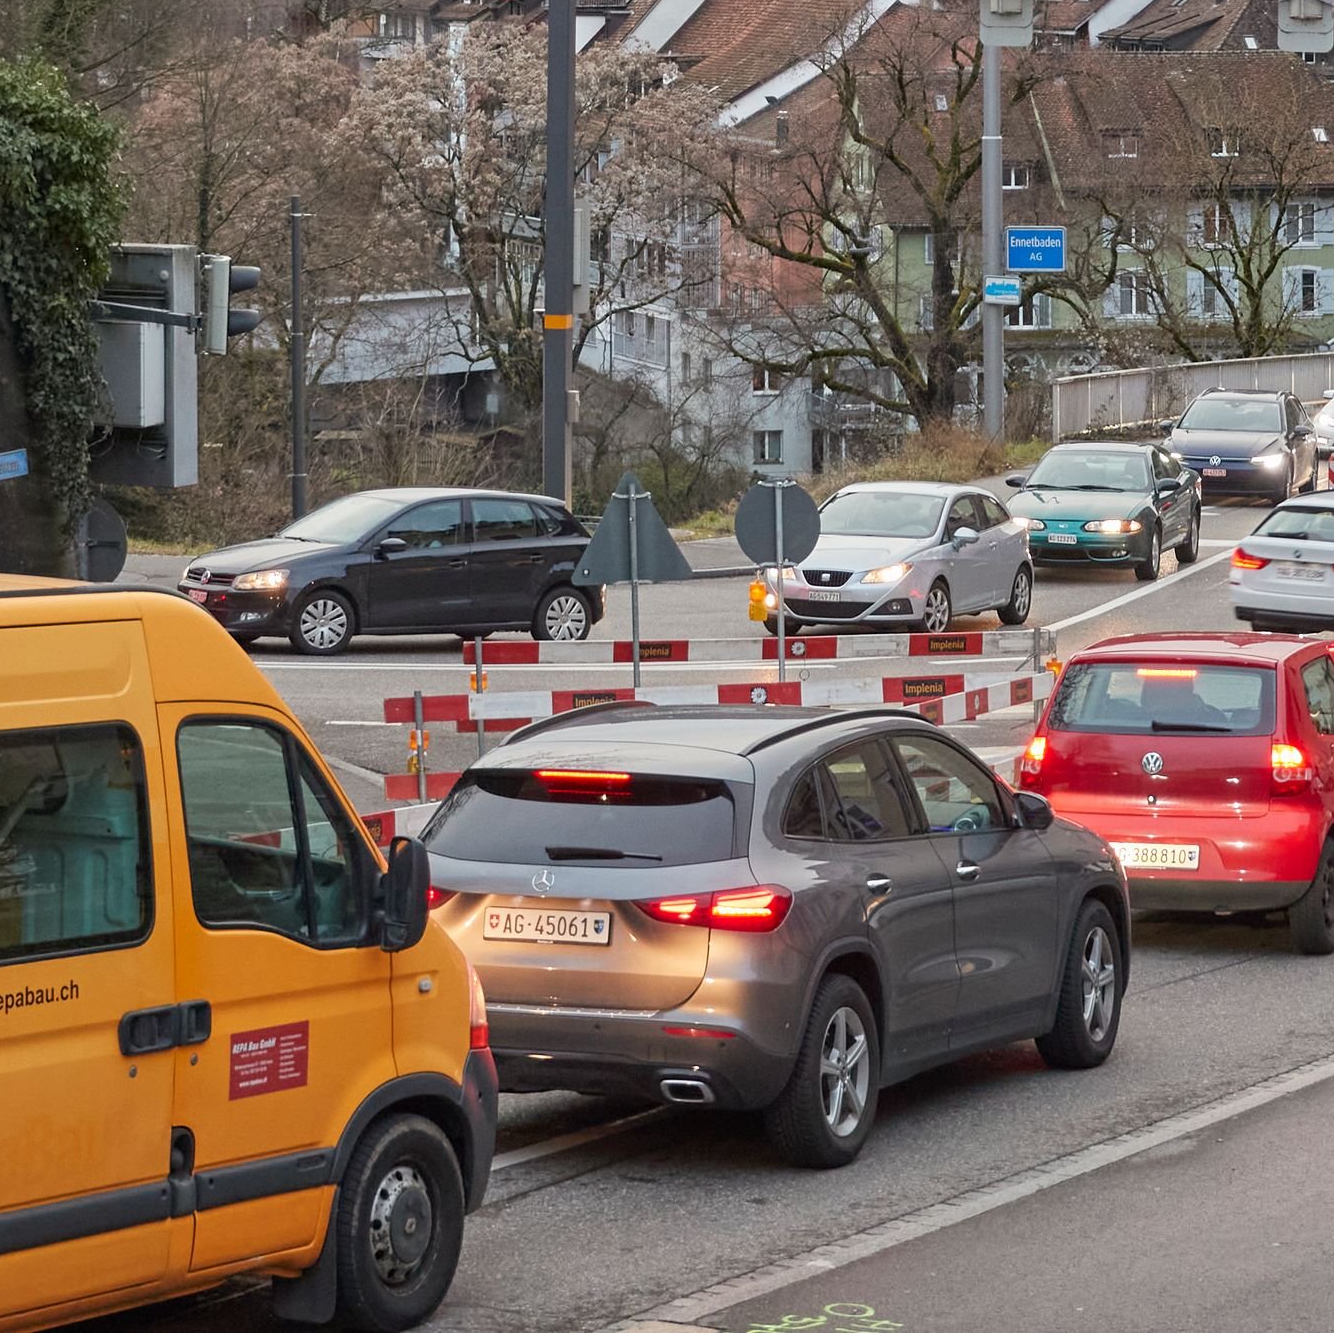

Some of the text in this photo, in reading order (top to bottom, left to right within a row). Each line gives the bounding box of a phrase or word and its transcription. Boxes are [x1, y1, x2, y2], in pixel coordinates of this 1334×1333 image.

[1010, 236, 1061, 248] Ennetbaden
[1029, 252, 1043, 261] AG
[930, 640, 965, 651] Implenia
[905, 682, 944, 696] Implenia
